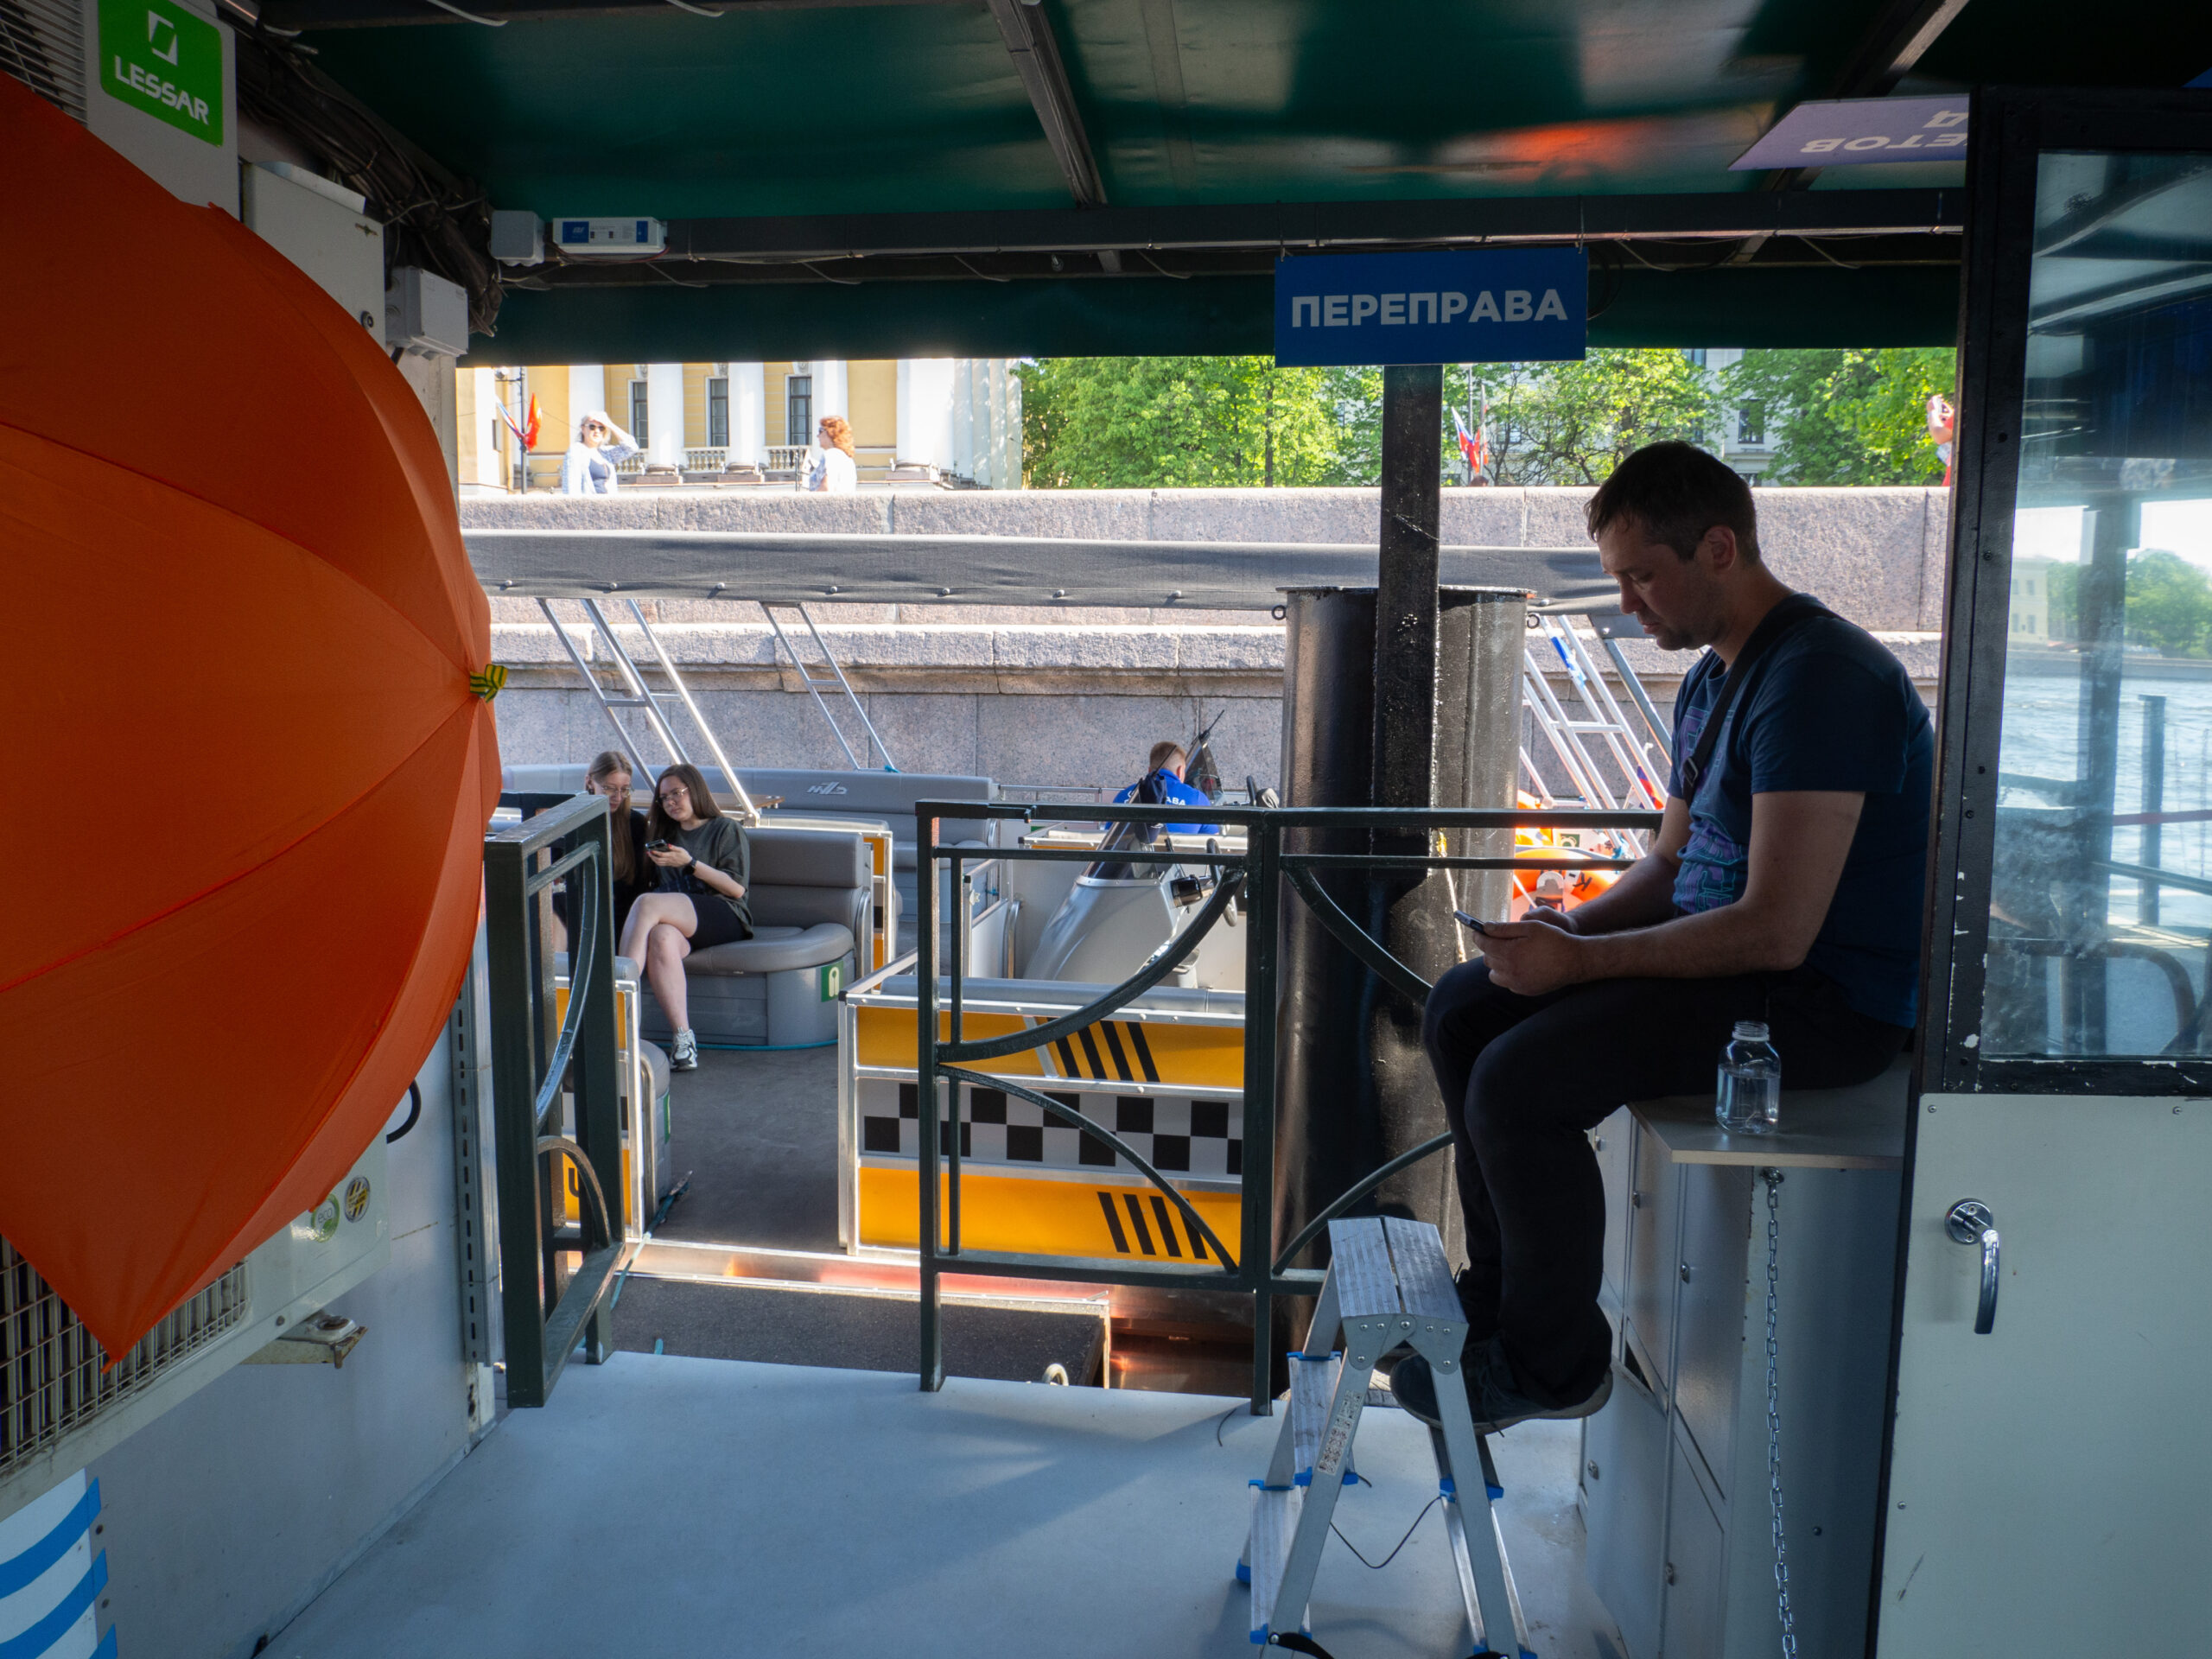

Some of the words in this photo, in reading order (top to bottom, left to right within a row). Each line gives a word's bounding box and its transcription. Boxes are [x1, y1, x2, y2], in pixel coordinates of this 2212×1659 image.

[114, 54, 209, 125] LESSAR
[1800, 132, 1968, 153] ЕТОВ
[1292, 289, 1568, 327] ПЕРЕПРАВА
